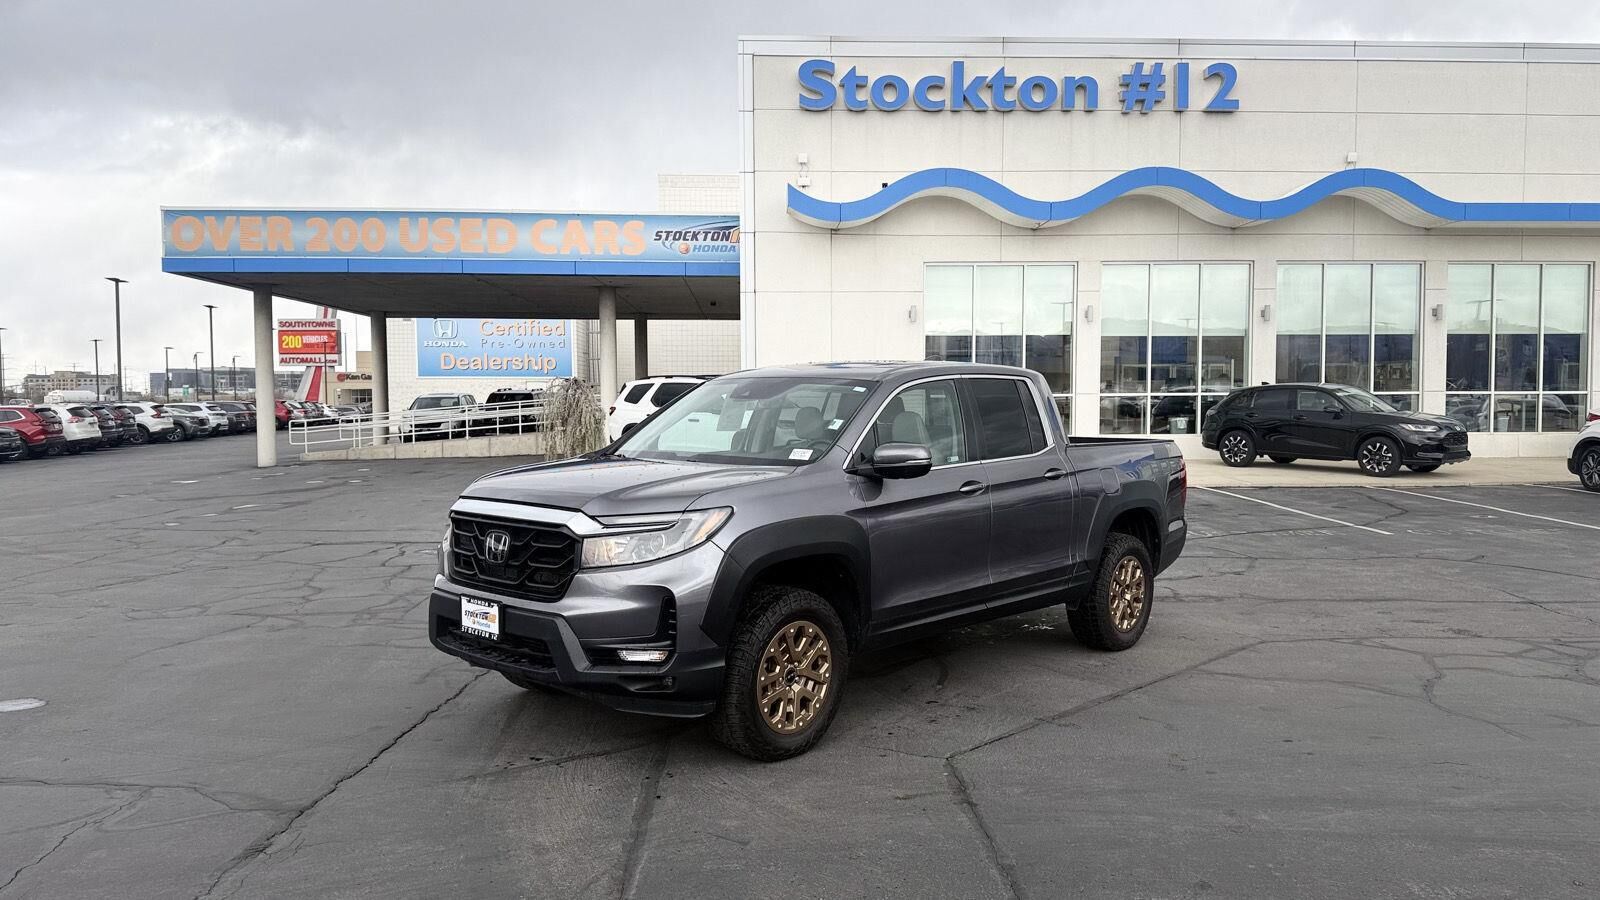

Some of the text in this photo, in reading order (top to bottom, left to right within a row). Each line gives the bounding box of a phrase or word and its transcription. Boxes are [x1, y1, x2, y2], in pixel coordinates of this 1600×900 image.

[798, 59, 1240, 114] Stockton #12
[171, 215, 647, 256] OVER 200 USED CARS
[654, 230, 732, 242] STOCKTON
[692, 244, 737, 253] HONDA
[480, 319, 567, 336] Certified
[282, 335, 302, 348] 200
[302, 335, 328, 343] VEHICLES
[423, 340, 468, 348] HONDA
[481, 338, 566, 349] Pre-Owned
[440, 352, 557, 374] Dealership
[470, 598, 489, 606] HONDA
[464, 610, 489, 620] STOCKTON
[461, 626, 489, 638] STOCKTON
